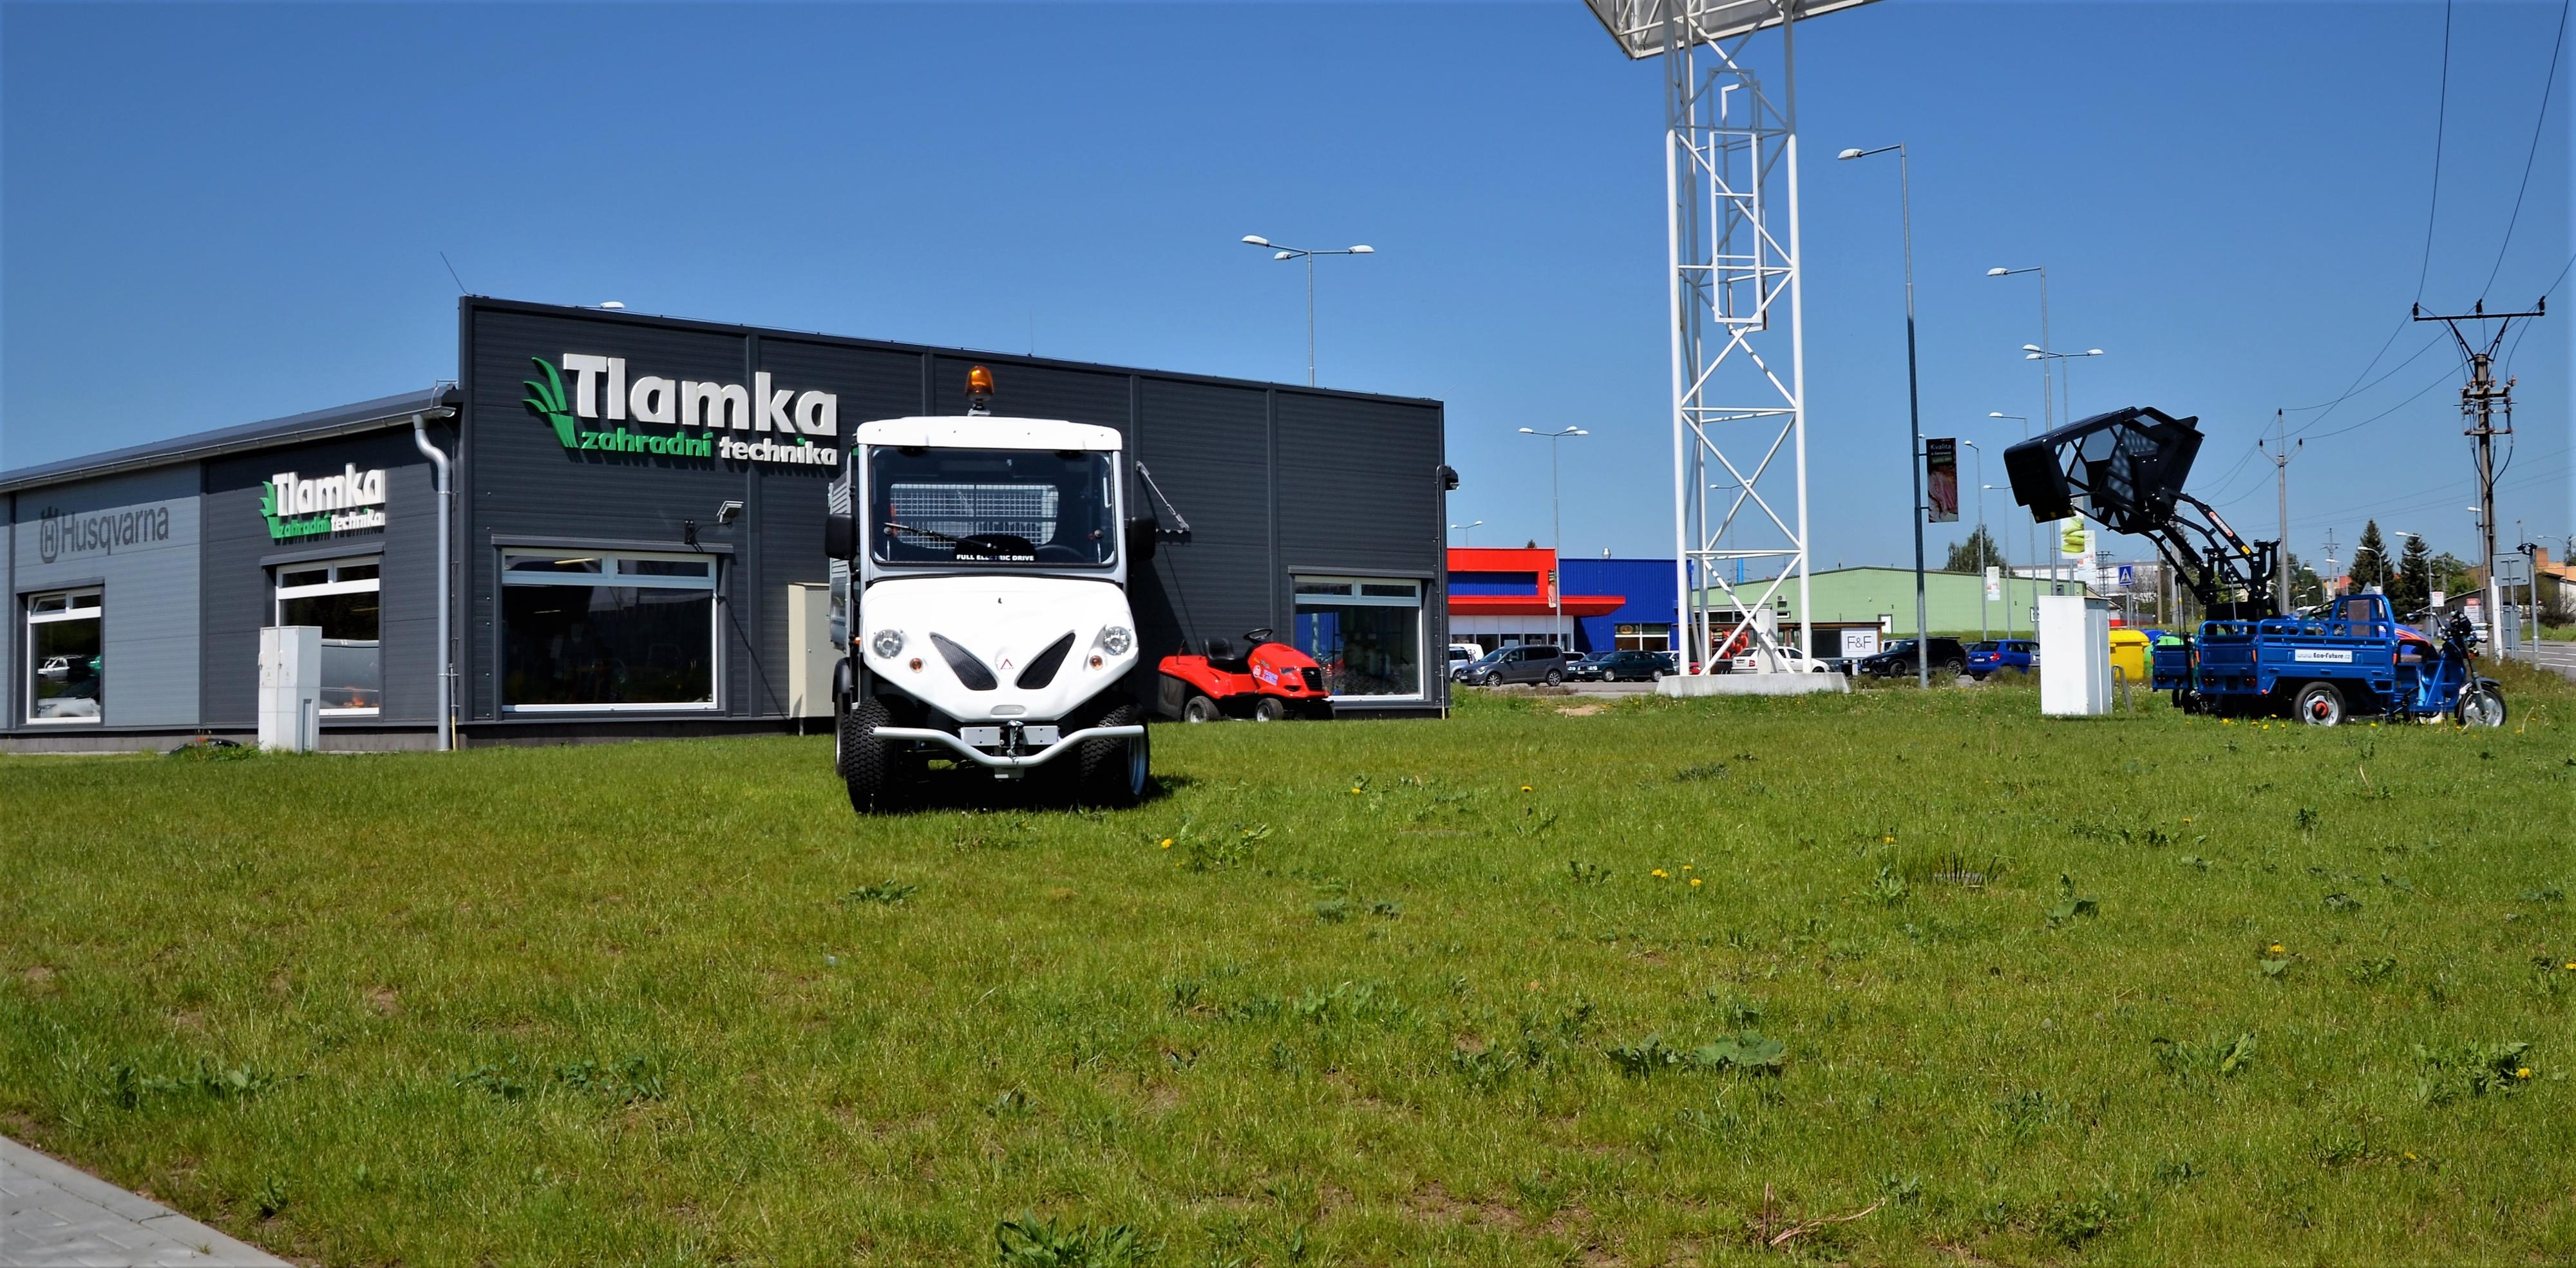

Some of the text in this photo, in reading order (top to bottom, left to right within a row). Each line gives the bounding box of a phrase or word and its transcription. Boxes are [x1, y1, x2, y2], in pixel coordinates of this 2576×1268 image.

[564, 353, 837, 436] Tlamka
[582, 428, 837, 465] zahradní technika
[272, 463, 385, 516] Tlamka
[62, 506, 169, 556] Husqvarna
[331, 508, 385, 531] technika
[1847, 636, 1871, 649] F&F
